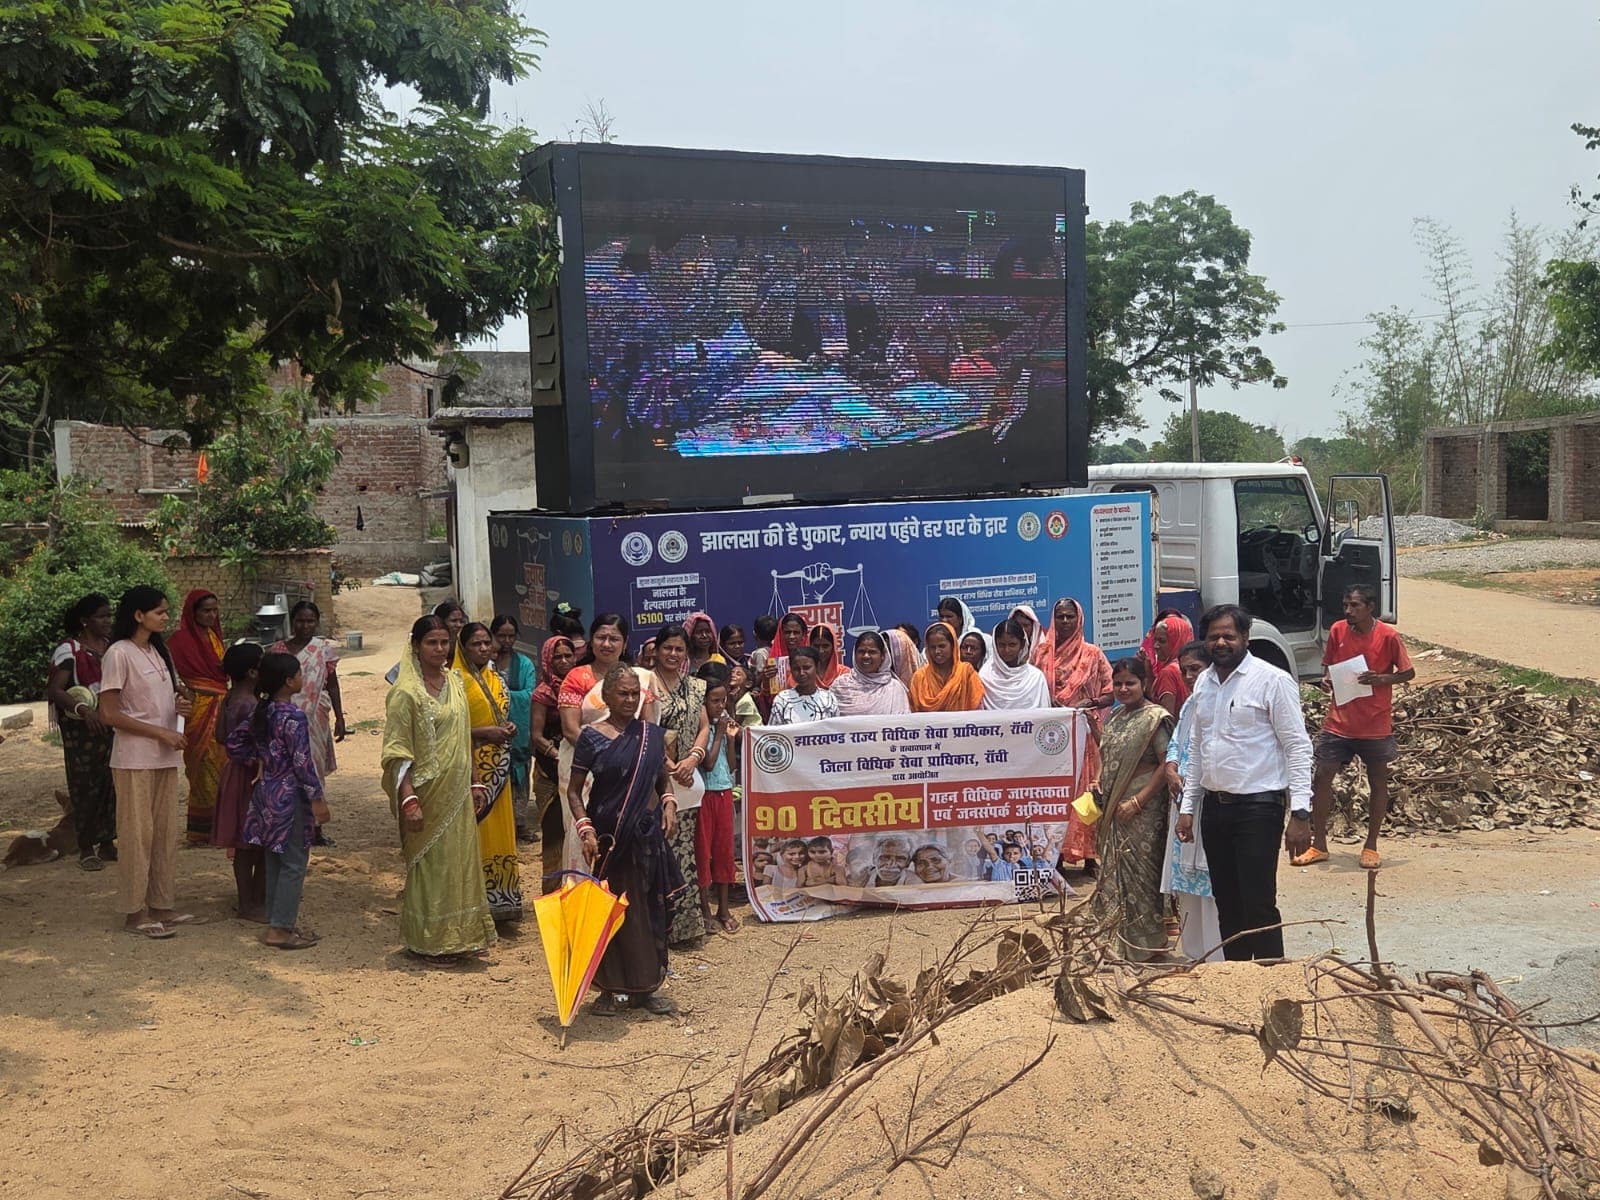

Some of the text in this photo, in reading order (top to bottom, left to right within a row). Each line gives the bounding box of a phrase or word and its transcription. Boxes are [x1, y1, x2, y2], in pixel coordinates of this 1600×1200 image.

[700, 529, 760, 553] झालसा
[761, 522, 784, 547] की
[785, 521, 799, 546] है
[800, 524, 846, 551] पुकार,
[848, 522, 887, 541] न्याय
[889, 515, 920, 544] पहुंचे
[921, 519, 943, 538] हर
[944, 518, 966, 537] घर
[967, 513, 982, 535] के
[983, 516, 1008, 538] द्वार
[652, 585, 687, 598] नालसा के
[636, 612, 663, 624] 15100
[664, 613, 674, 623] पर
[794, 733, 846, 747] झारखण्ड
[850, 731, 878, 744] राज्य
[882, 727, 920, 742] विधिक
[924, 725, 948, 739] सेवा
[953, 723, 1004, 738] प्राधिकार,
[819, 759, 852, 773] जिला
[857, 757, 896, 771] विधिक
[899, 754, 923, 768] सेवा
[927, 752, 979, 767] प्राधिकार,
[929, 791, 958, 804] गहन
[962, 786, 1003, 802] विधिक
[755, 792, 922, 832] 90 दिवसीय
[932, 801, 1067, 821] एवं जनसंपर्क अभियान
